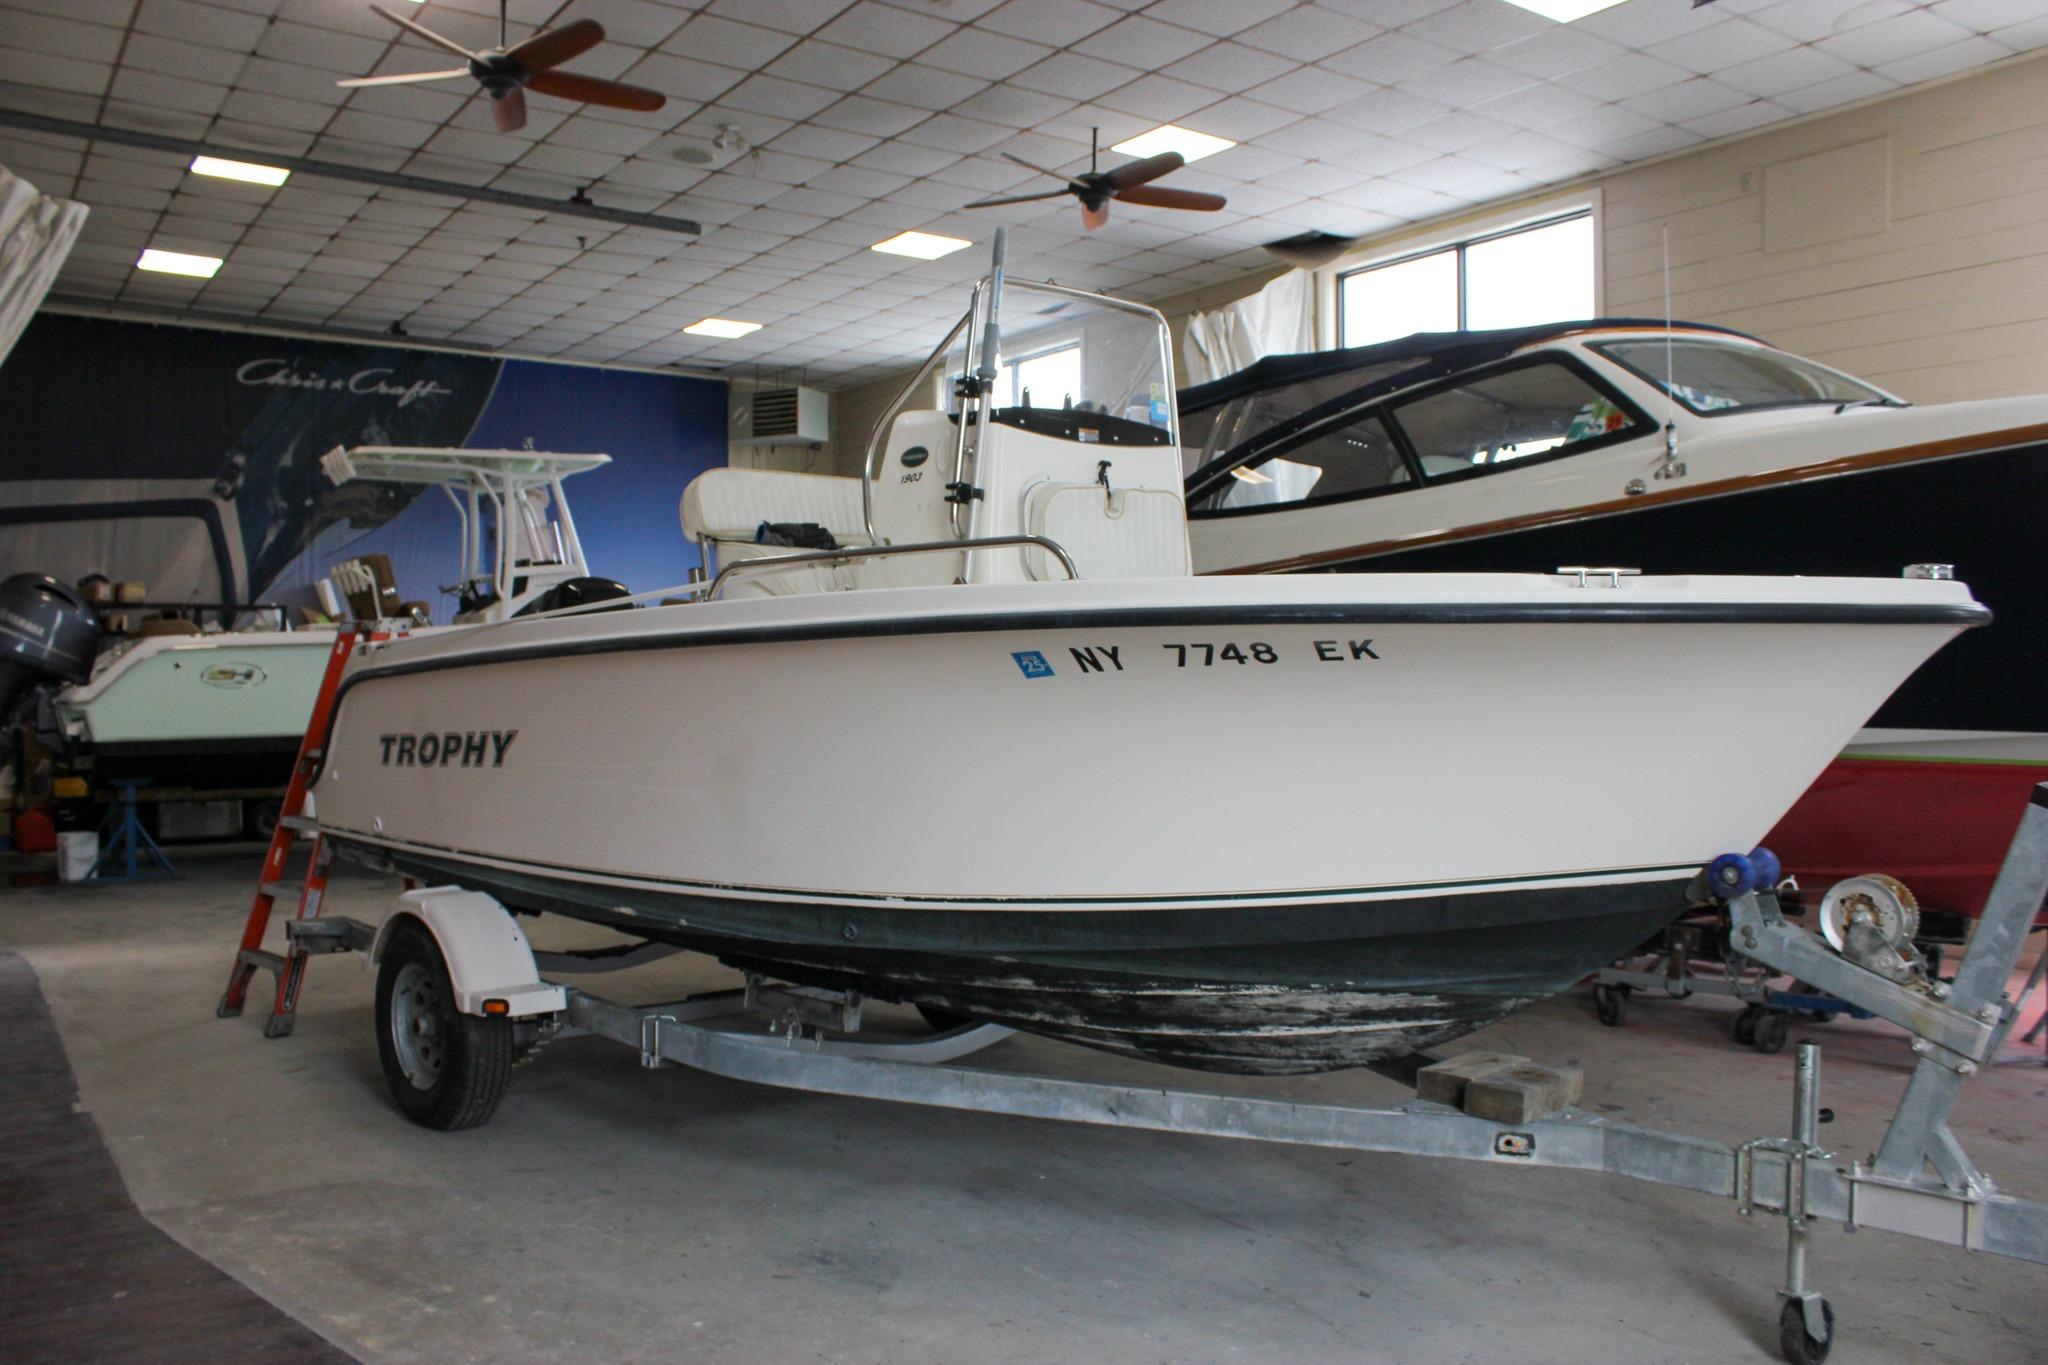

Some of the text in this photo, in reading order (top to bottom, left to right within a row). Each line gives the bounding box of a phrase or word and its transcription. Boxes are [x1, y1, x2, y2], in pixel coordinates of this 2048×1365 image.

[236, 358, 452, 408] Chris Craft
[1068, 639, 1380, 673] NY 7748 EK
[380, 730, 519, 767] TROPHY
